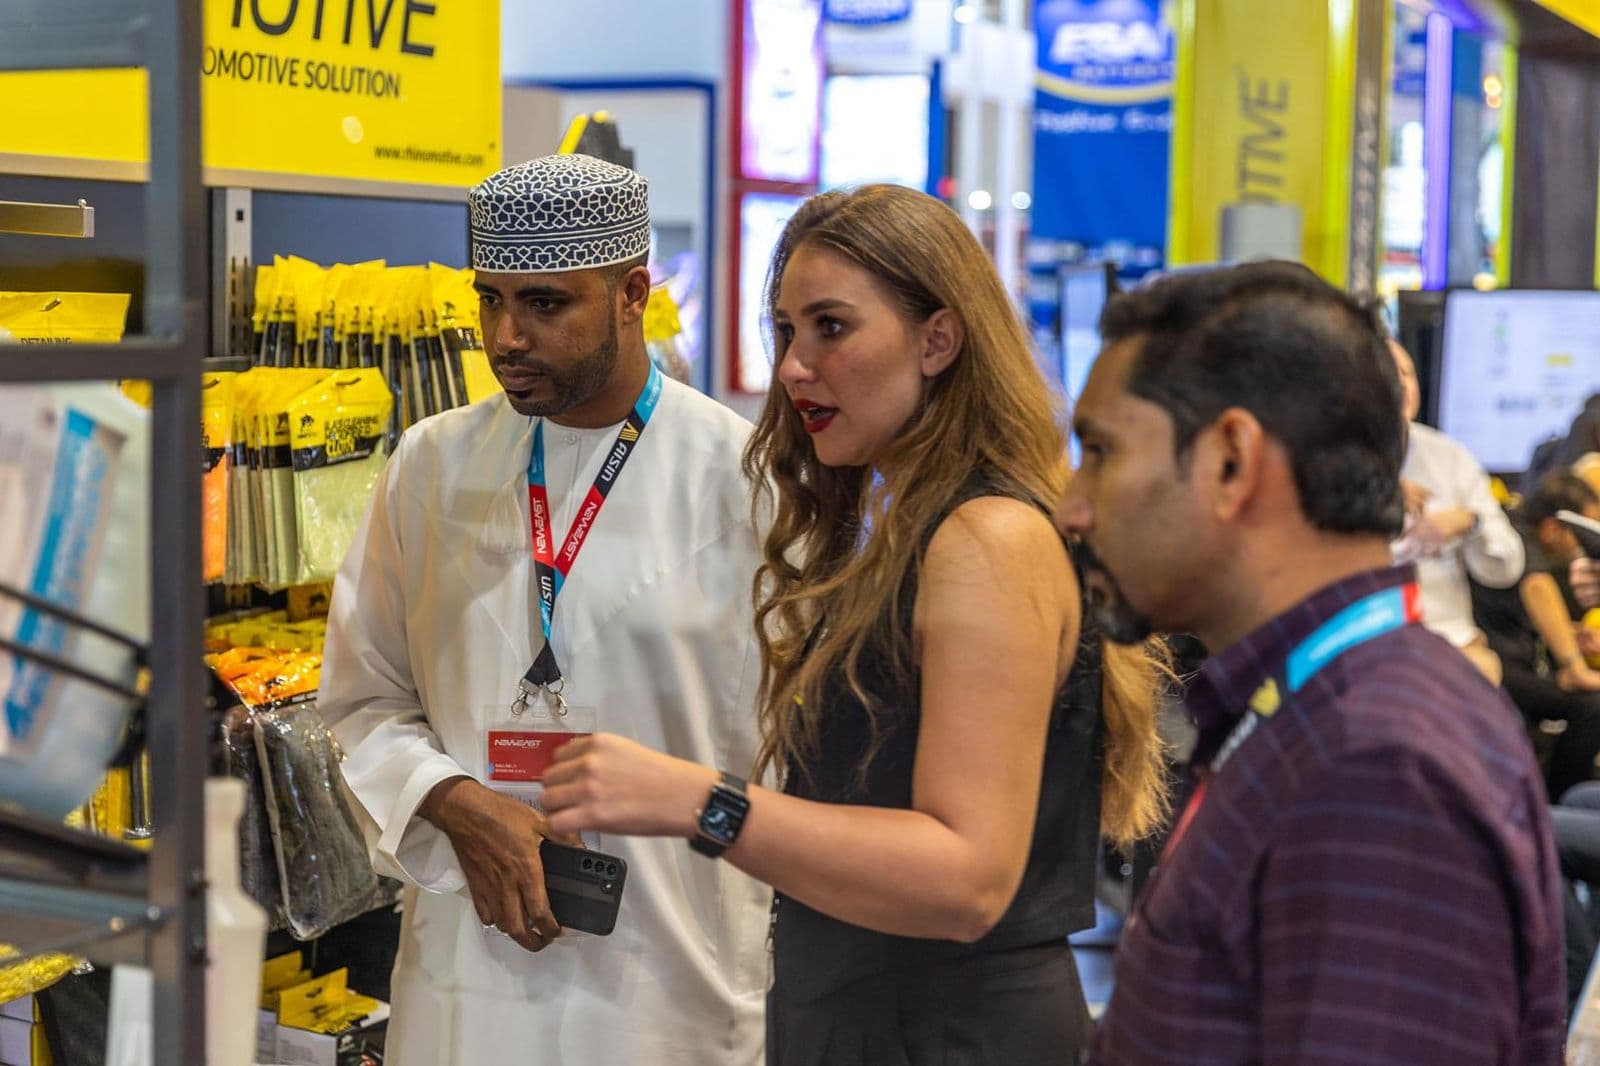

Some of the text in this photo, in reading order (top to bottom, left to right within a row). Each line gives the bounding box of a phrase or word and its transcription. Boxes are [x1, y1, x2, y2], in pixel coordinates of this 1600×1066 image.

[304, 60, 401, 98] SOLUTION
[601, 442, 627, 482] AISIN
[533, 497, 547, 555] NEWEAST
[565, 501, 597, 561] NEWEAST
[541, 575, 552, 612] ISIN
